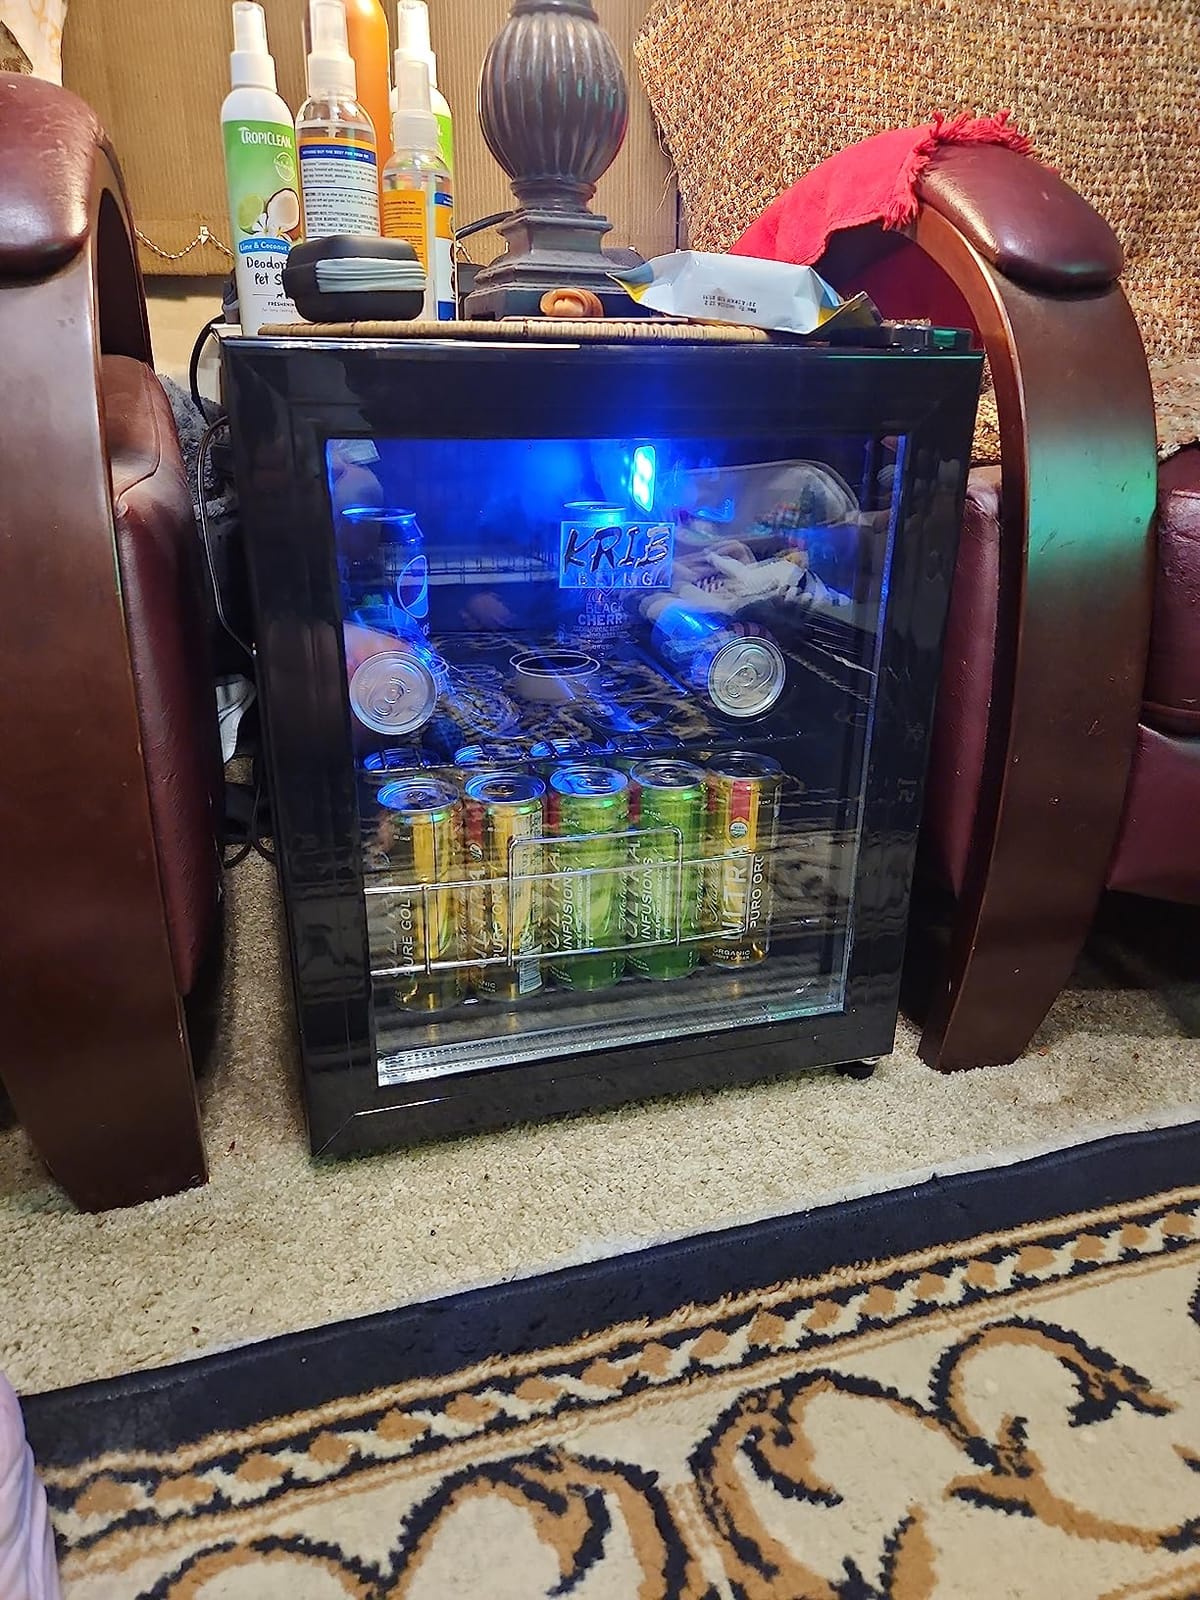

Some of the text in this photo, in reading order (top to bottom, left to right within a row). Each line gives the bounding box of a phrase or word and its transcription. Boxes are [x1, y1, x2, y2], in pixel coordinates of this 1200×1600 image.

[254, 241, 260, 249] &
[261, 241, 288, 251] Coconut
[247, 256, 287, 270] Deodor
[255, 272, 269, 285] Pet
[564, 526, 670, 573] KRIB
[586, 602, 624, 614] BLACK
[640, 857, 654, 940] INFUSIONS
[400, 891, 413, 930] GOL
[713, 946, 750, 956] ORGANIC
